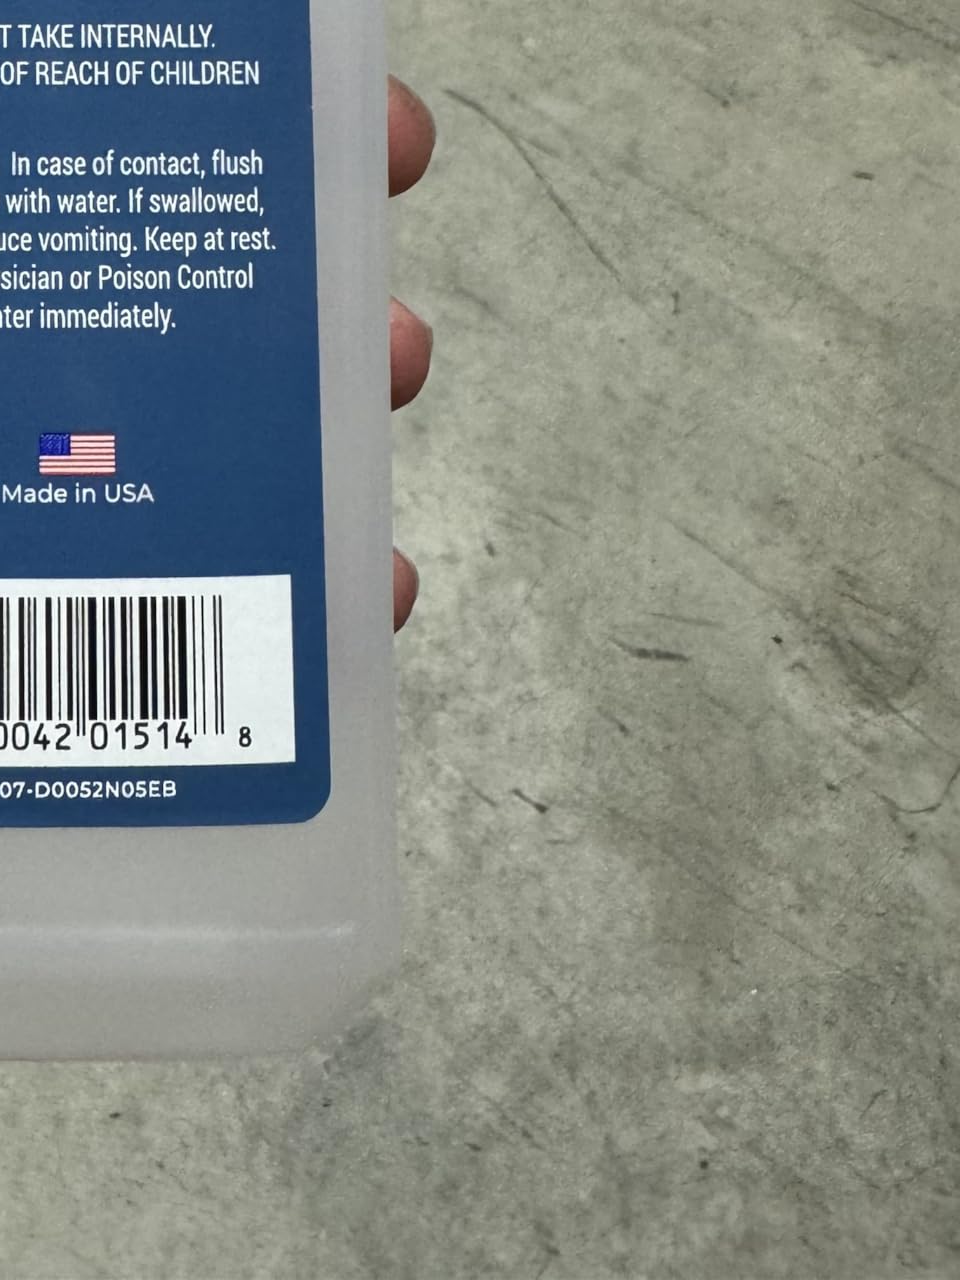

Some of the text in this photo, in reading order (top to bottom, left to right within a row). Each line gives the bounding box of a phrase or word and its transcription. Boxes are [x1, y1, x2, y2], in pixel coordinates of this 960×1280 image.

[17, 23, 75, 49] TAKE
[80, 23, 216, 49] INTERNALLY.
[0, 60, 30, 86] OF
[35, 60, 110, 86] REACH
[115, 60, 146, 86] OF
[150, 60, 260, 86] CHILDREN
[11, 151, 31, 176] In
[36, 156, 87, 176] case
[91, 148, 115, 176] of
[119, 152, 206, 180] contact,
[211, 148, 263, 176] flush
[5, 187, 51, 214] with
[56, 190, 121, 214] water.
[128, 186, 144, 214] If
[148, 186, 265, 217] swallowed,
[37, 224, 138, 258] vomiting.
[144, 225, 198, 258] Keep
[203, 227, 225, 252] at
[230, 227, 277, 251] rest.
[69, 270, 92, 290] or
[98, 262, 171, 290] Poison
[177, 261, 254, 290] Control
[39, 300, 176, 335] immediately.
[2, 482, 155, 504] Made in USA
[89, 722, 193, 751] 01514
[238, 726, 252, 748] 8
